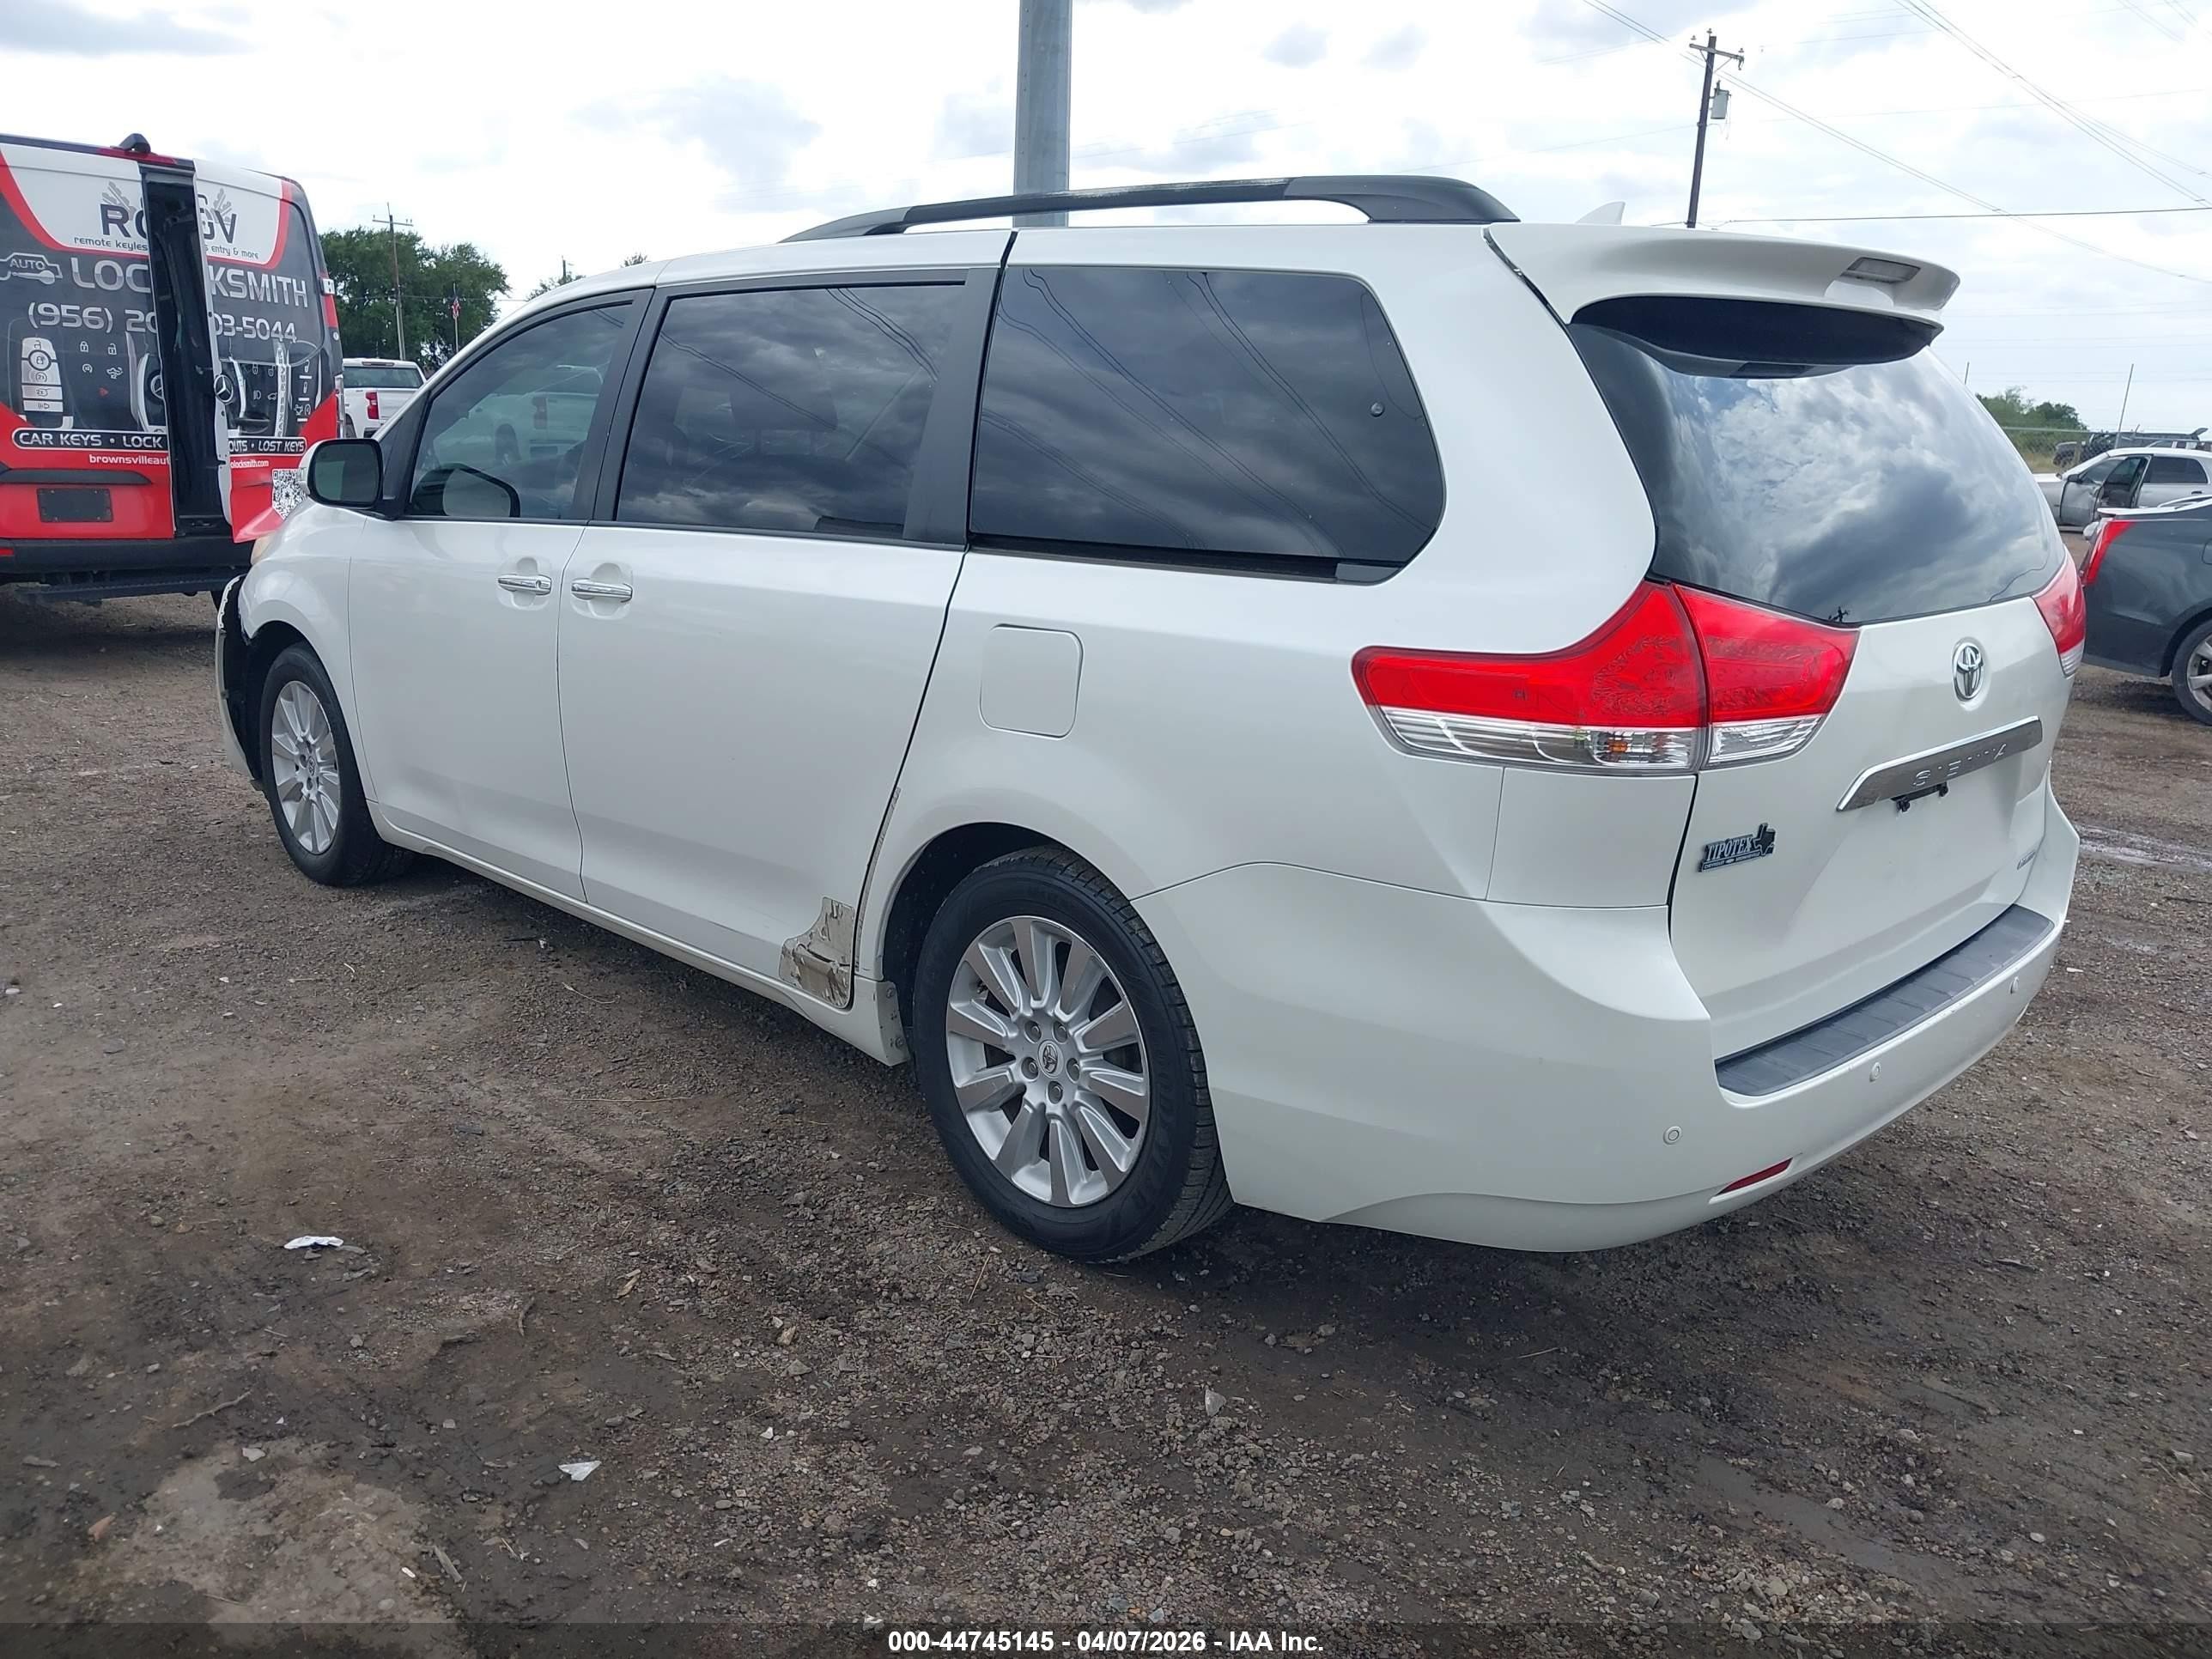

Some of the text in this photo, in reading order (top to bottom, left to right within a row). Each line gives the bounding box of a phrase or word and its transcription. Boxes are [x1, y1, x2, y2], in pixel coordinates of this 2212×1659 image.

[74, 236, 112, 247] remote
[211, 245, 231, 257] entry
[233, 246, 239, 255] &
[241, 250, 259, 259] more
[10, 258, 46, 270] AUTO
[208, 265, 308, 308] KSMITH
[27, 301, 113, 334] (956)
[19, 432, 163, 448] CAR KEYS LOCK
[228, 440, 305, 452] OUTS LOST KEYS
[1706, 836, 1753, 861] TIPOTEX
